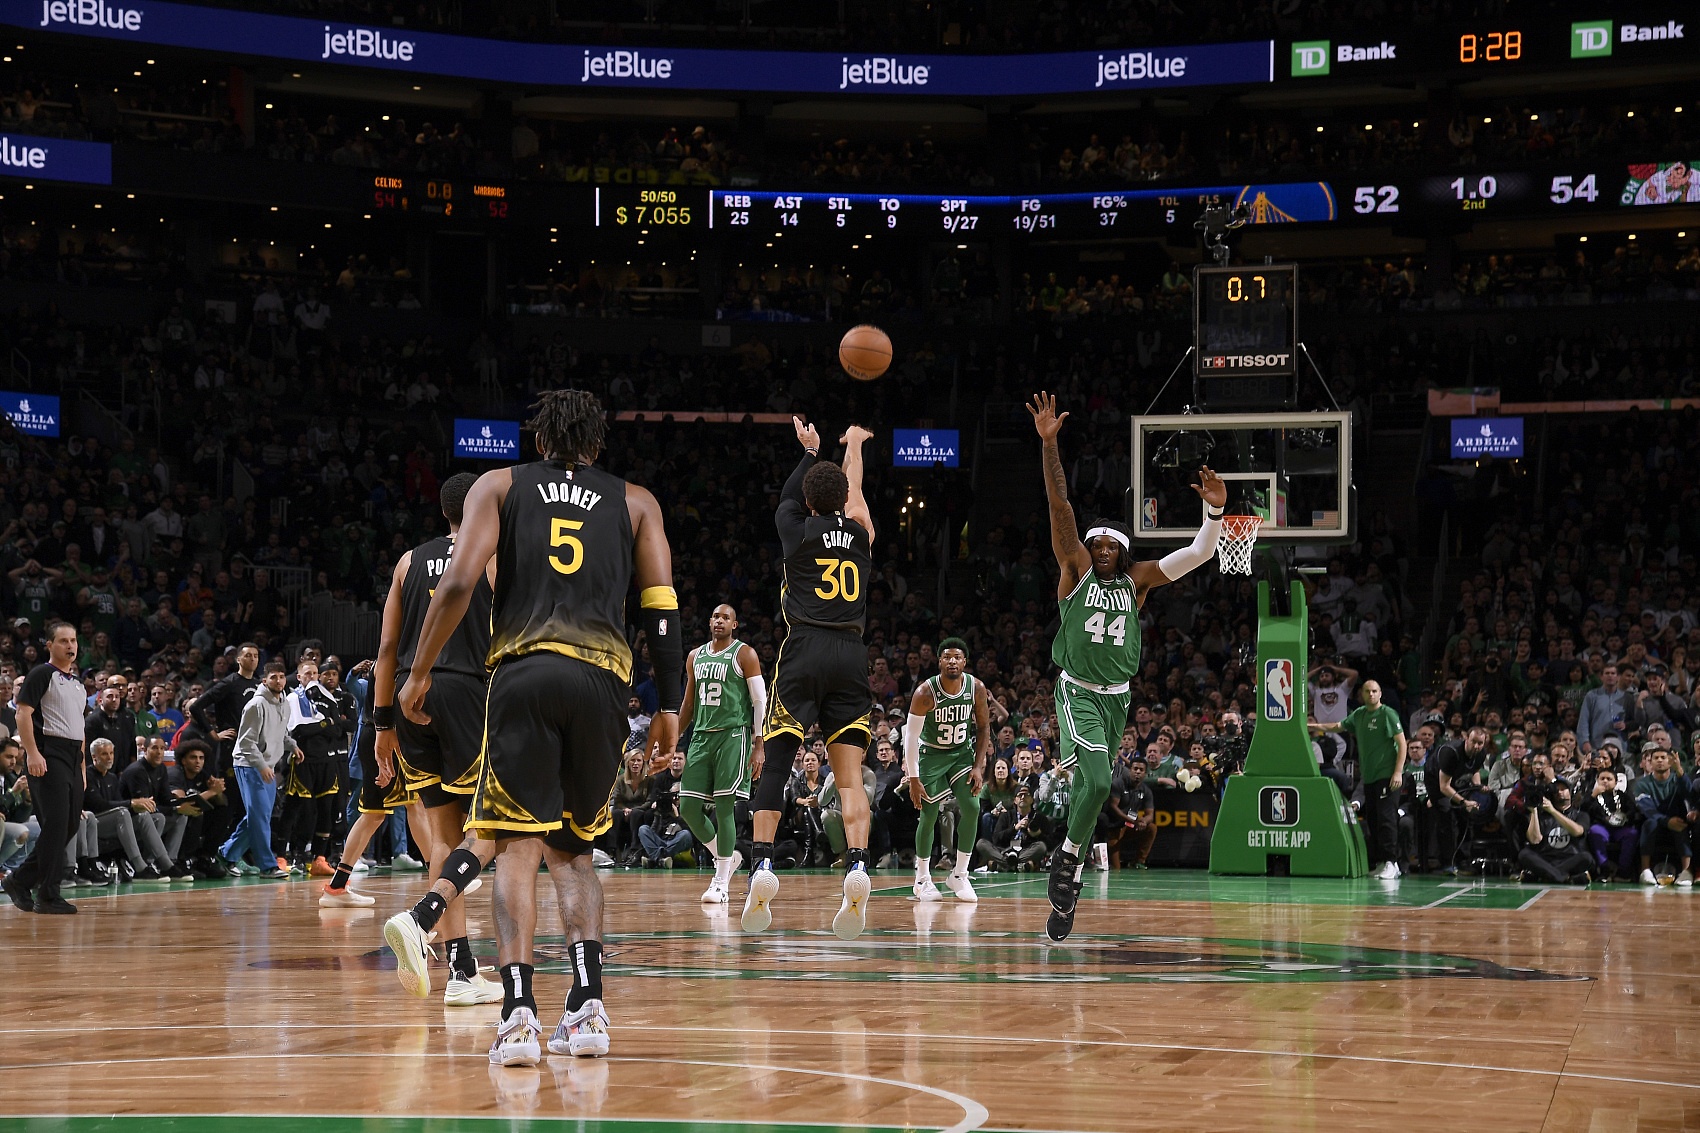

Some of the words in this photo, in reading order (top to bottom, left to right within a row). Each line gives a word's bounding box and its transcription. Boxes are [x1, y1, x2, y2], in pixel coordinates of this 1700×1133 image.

[40, 0, 141, 31] jetBlue
[321, 25, 416, 62] jetBlue
[1459, 30, 1522, 63] 8:28
[1575, 27, 1609, 51] TD
[1620, 20, 1684, 43] Bank
[581, 49, 674, 82] jetBlue
[1295, 47, 1326, 70] TD
[1337, 41, 1396, 62] Bank
[839, 57, 931, 90] jetBlue
[1095, 51, 1188, 88] jetBlue
[374, 176, 403, 189] CELTICS
[473, 184, 506, 198] WARRIORS
[1450, 175, 1497, 200] 1.0
[1550, 173, 1599, 204] 54
[640, 190, 677, 203] 50/50
[724, 194, 752, 208] REB
[774, 195, 803, 209] AST
[828, 196, 853, 210] STL
[878, 198, 900, 212] TO
[940, 199, 968, 213] 3PT
[1021, 198, 1042, 212] FG
[1093, 195, 1128, 210] FG%
[1158, 196, 1180, 206] TOL
[1353, 185, 1400, 214] 52
[1462, 199, 1486, 210] 2nd
[616, 206, 628, 225] $
[730, 211, 749, 225] 25
[780, 212, 799, 227] 14
[836, 213, 846, 228] 5
[887, 214, 897, 229] 9
[943, 215, 979, 233] 9/27
[1013, 214, 1056, 233] 19/51
[1099, 211, 1118, 226] 37
[1165, 209, 1175, 223] 5
[1227, 275, 1266, 302] 0.7
[1226, 353, 1290, 368] TISSOT
[457, 436, 516, 449] ARBELLA
[464, 446, 508, 454] INSURANCE
[896, 446, 955, 456] ARBELLA
[1454, 436, 1519, 447] ARBELLA
[1462, 445, 1511, 453] INSURANCE
[536, 482, 602, 512] LOONEY
[548, 516, 585, 576] 5
[822, 530, 855, 550] CURRY
[814, 557, 860, 603] 30
[1084, 582, 1132, 613] BOSTON
[1084, 611, 1127, 647] 44
[694, 661, 729, 682] BOSTON
[698, 681, 722, 707] 42
[934, 703, 973, 723] BOSTON
[1268, 706, 1283, 717] NBA
[936, 722, 968, 745] 36
[1247, 829, 1268, 848] GET
[1268, 830, 1289, 848] THE
[1290, 830, 1311, 849] APP
